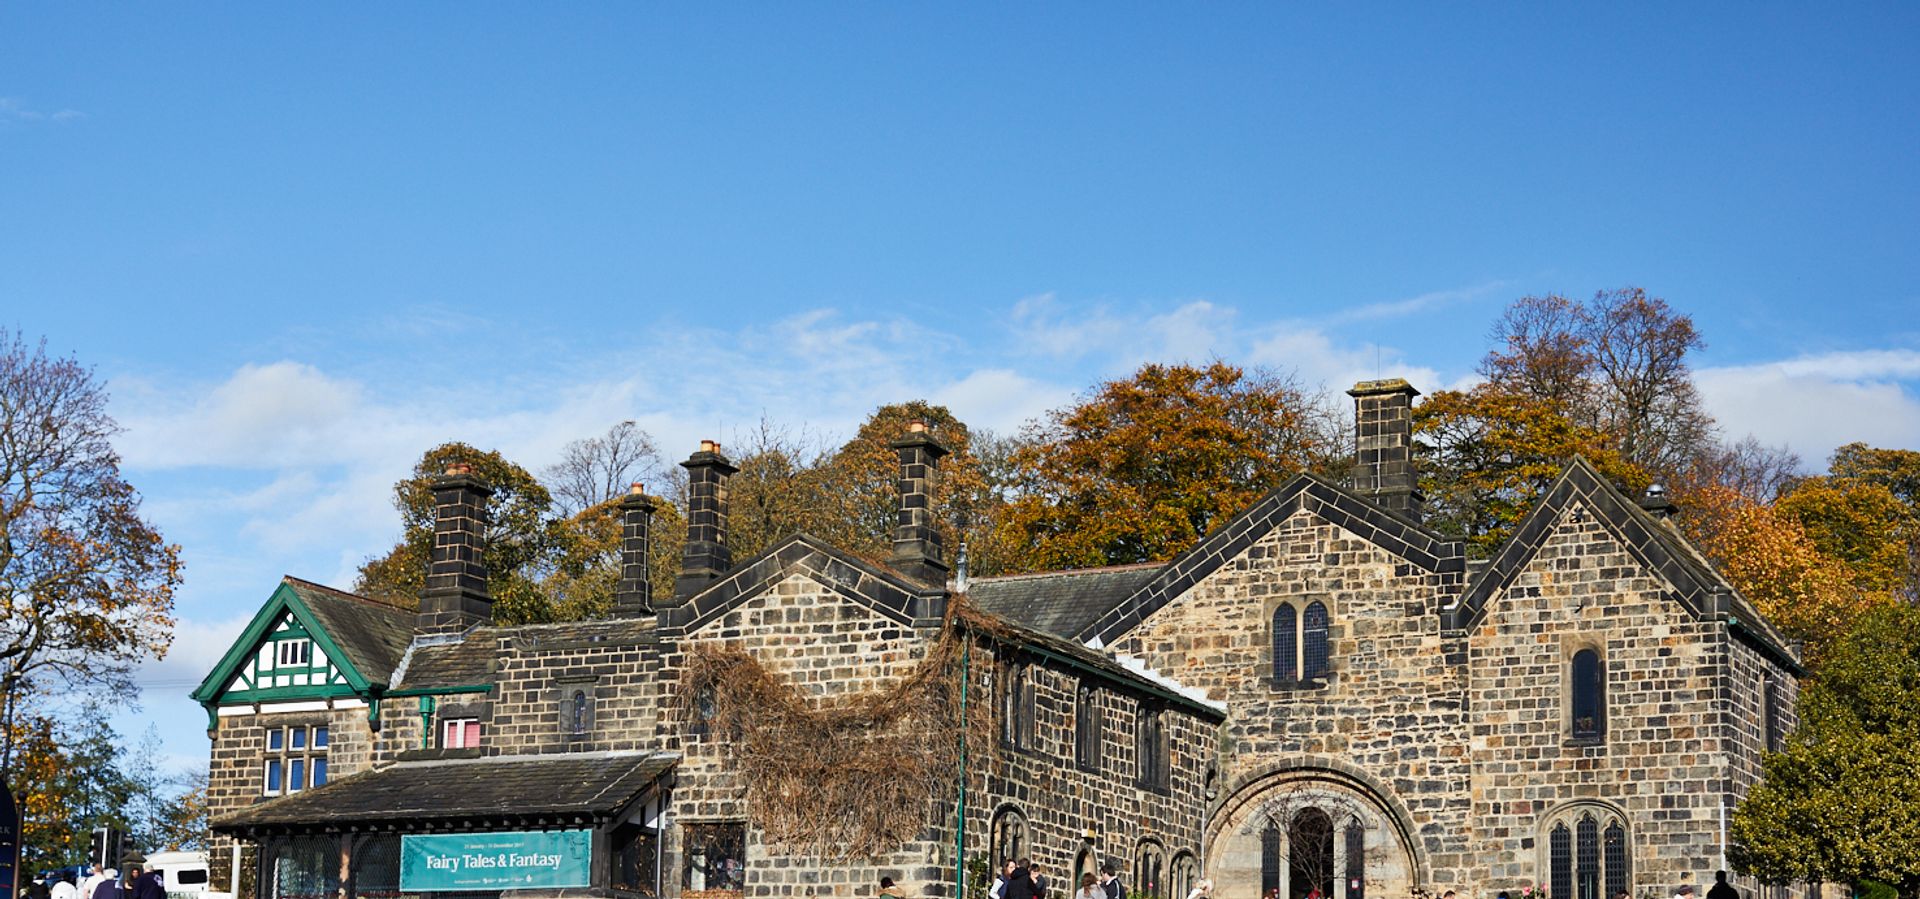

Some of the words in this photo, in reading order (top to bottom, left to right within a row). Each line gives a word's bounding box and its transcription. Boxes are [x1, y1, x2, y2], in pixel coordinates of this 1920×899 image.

[426, 854, 460, 873] Fairy
[462, 853, 496, 868] Tales
[497, 853, 507, 868] &
[509, 852, 563, 871] Fantasy
